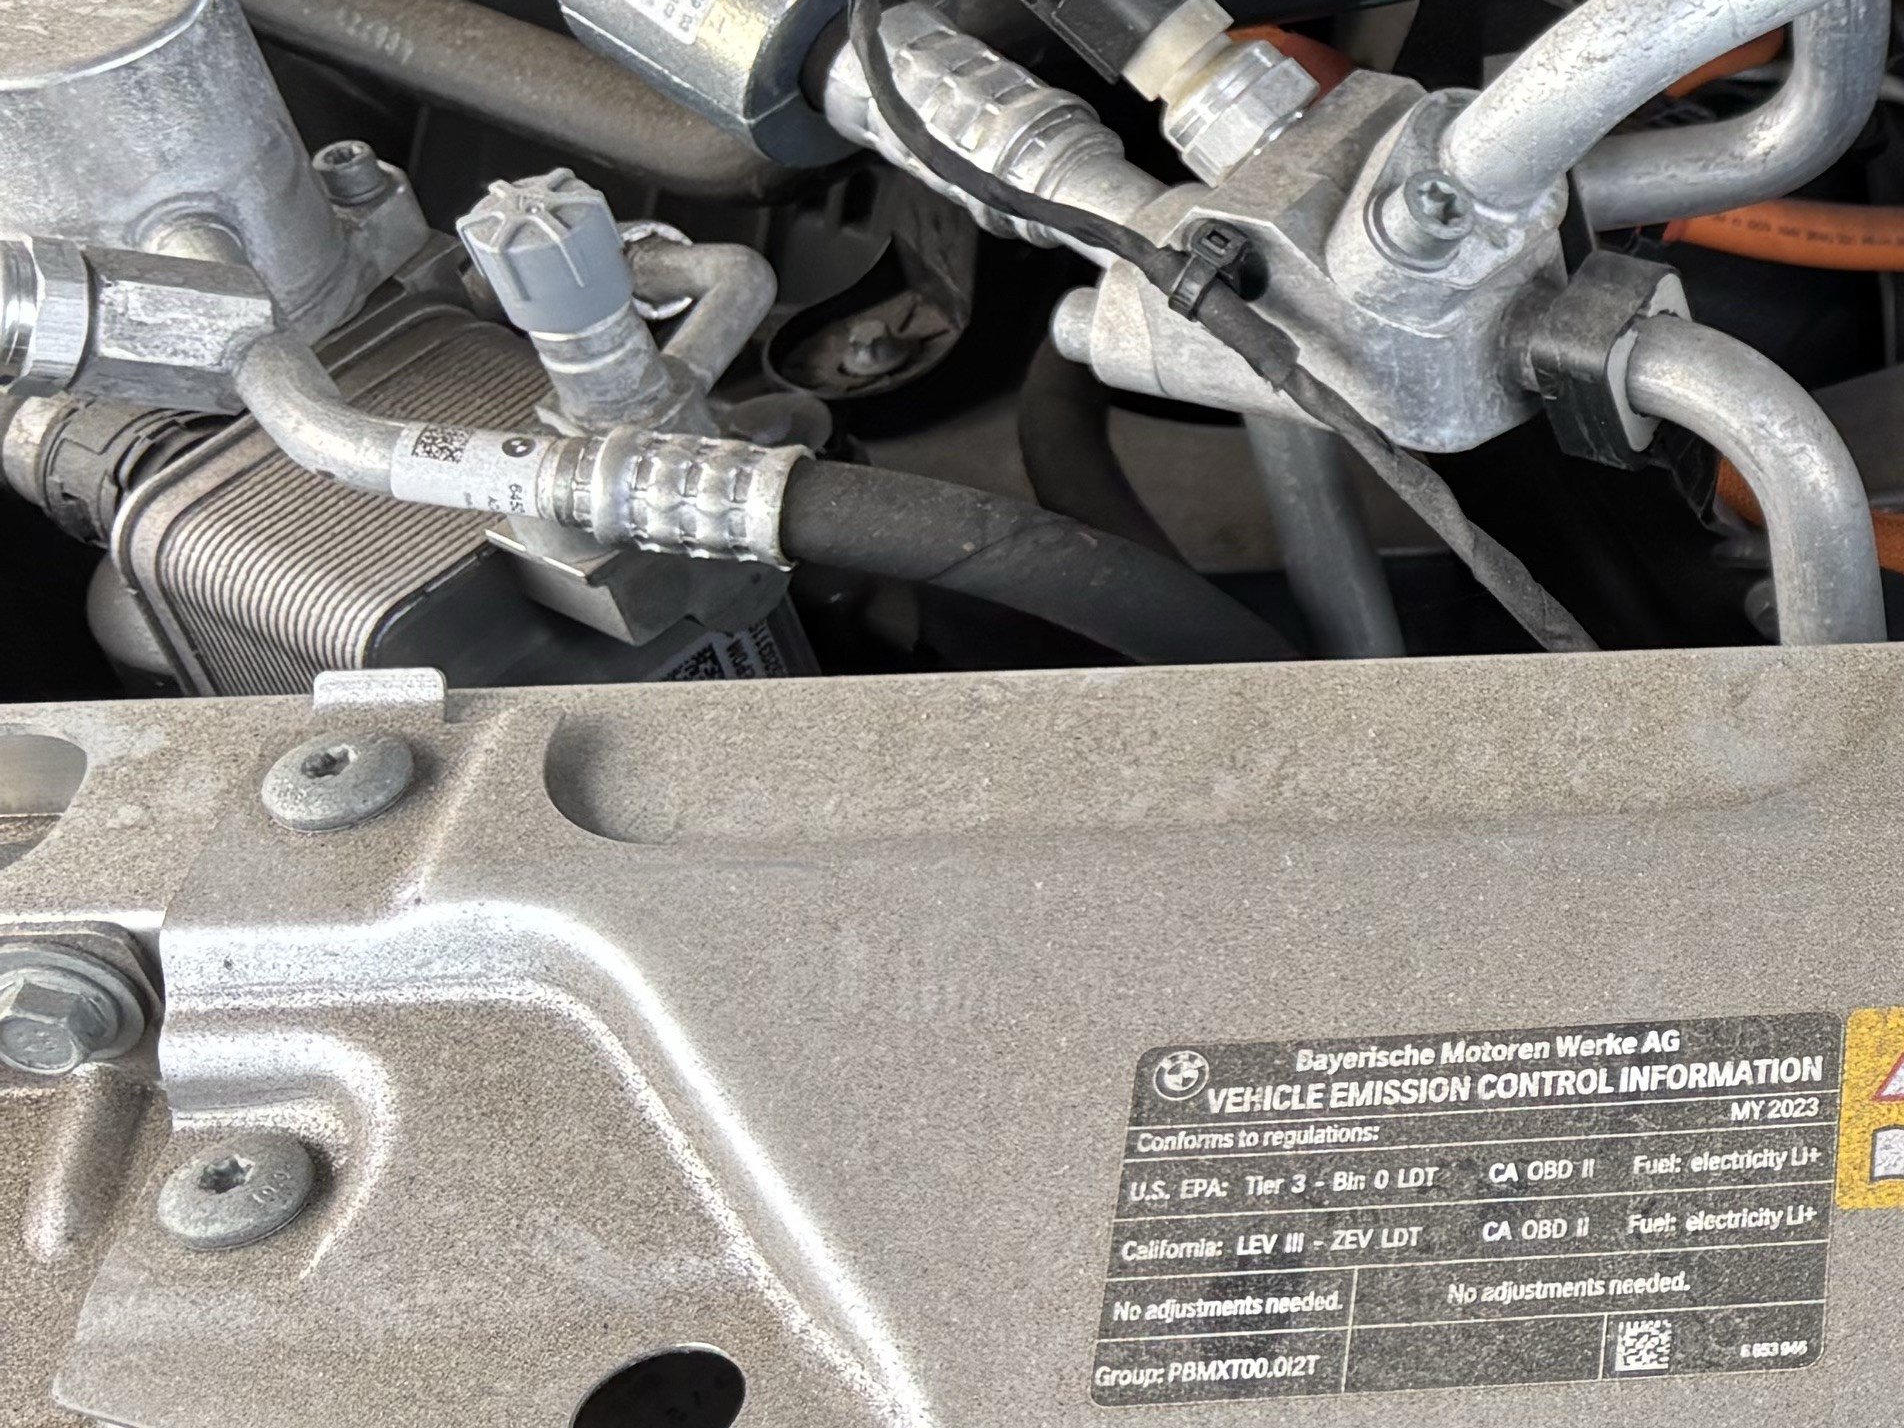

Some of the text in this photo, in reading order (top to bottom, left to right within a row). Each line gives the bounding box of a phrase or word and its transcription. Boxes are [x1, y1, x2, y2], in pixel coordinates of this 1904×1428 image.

[1298, 1030, 1681, 1074] Bayerische Motoren Werke AG
[1208, 1056, 1823, 1116] VEHICLE EMISSION CONTROL INFORMATION
[1730, 1096, 1820, 1122] MY 2023
[1137, 1123, 1379, 1153] Conforms to regulations:
[1488, 1162, 1518, 1184] CA
[1527, 1160, 1573, 1182] OBD
[1633, 1153, 1681, 1175] Fuel:
[1691, 1148, 1786, 1175] electricity
[1129, 1179, 1170, 1202] U.S.
[1179, 1176, 1229, 1200] EPA:
[1245, 1174, 1283, 1196] Tier
[1291, 1174, 1306, 1194] 3
[1374, 1169, 1388, 1190] 0
[1396, 1167, 1438, 1188] LDT
[1482, 1221, 1512, 1243] CA
[1521, 1218, 1568, 1241] OBD
[1627, 1213, 1676, 1235] Fuel:
[1685, 1207, 1783, 1234] electricity
[1121, 1238, 1222, 1263] California:
[1236, 1233, 1277, 1255] LEV
[1284, 1231, 1304, 1253] III
[1331, 1229, 1374, 1251] ZEV
[1381, 1226, 1420, 1248] LDT
[1447, 1272, 1691, 1307] No adjustments needed.
[1113, 1292, 1343, 1325] No adjustments needed.
[1096, 1365, 1163, 1389] Group:
